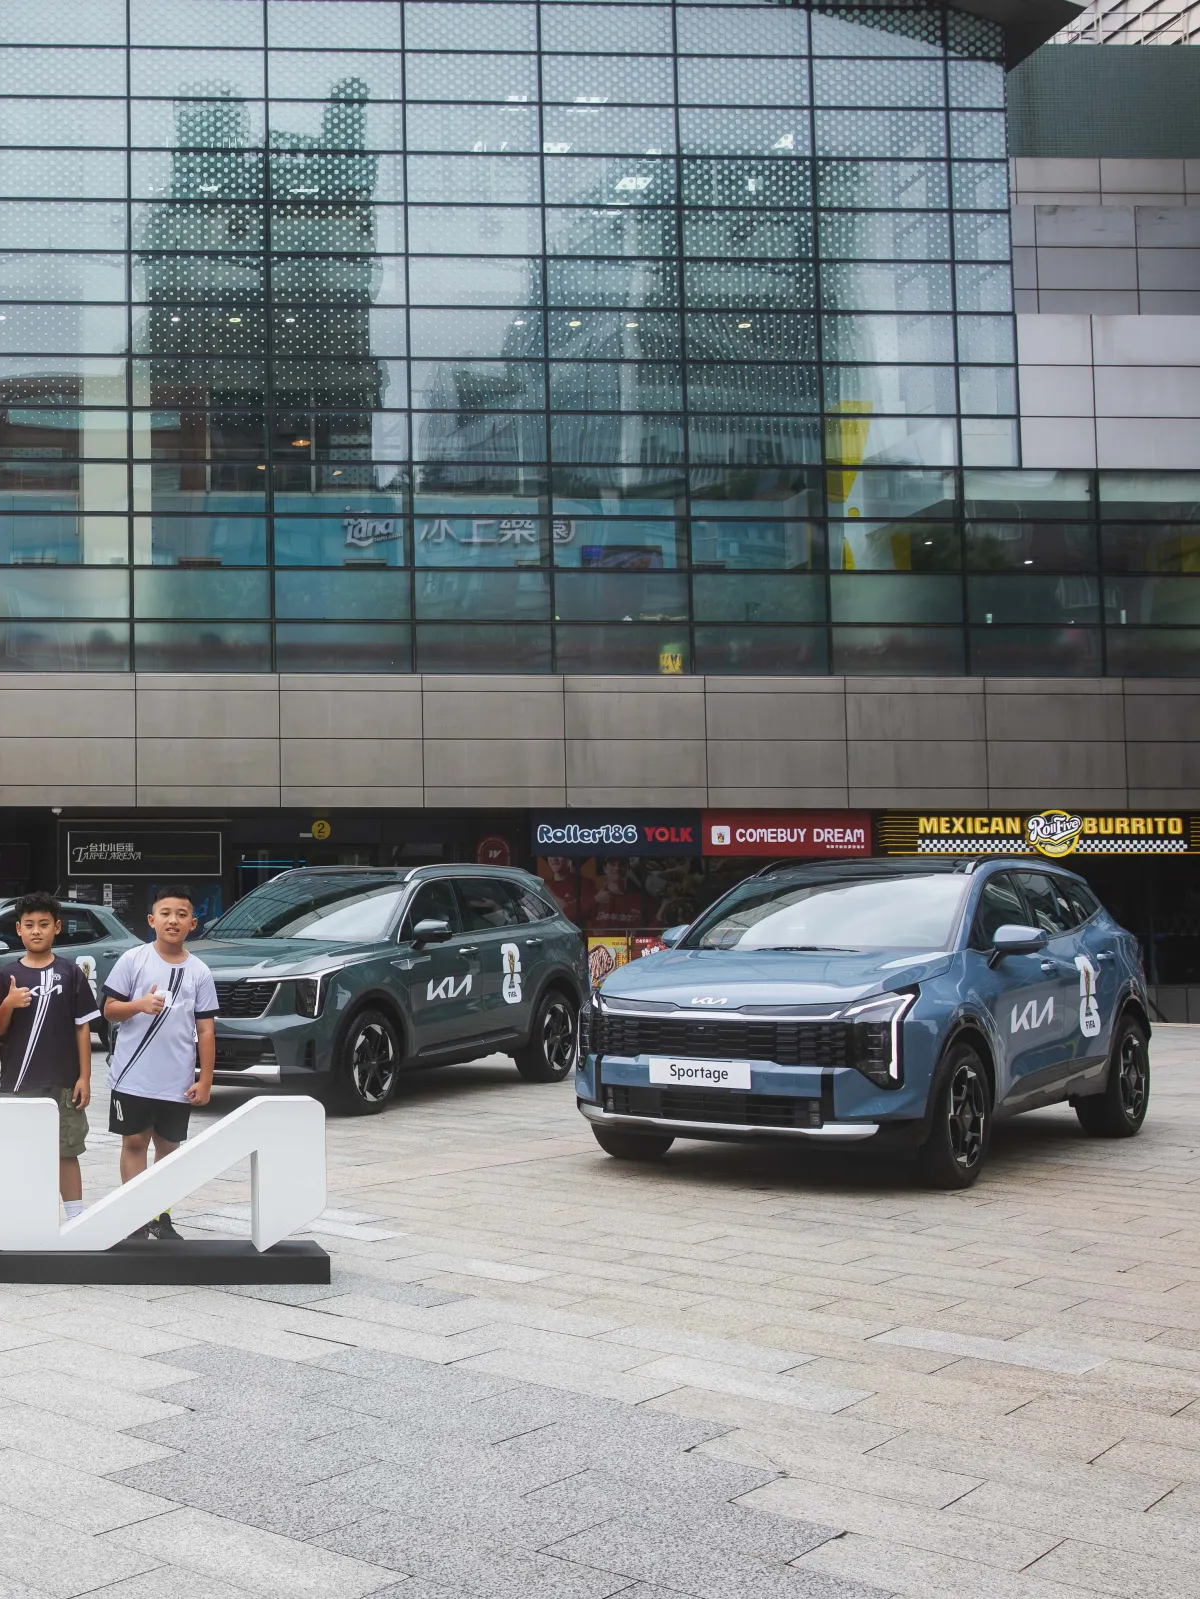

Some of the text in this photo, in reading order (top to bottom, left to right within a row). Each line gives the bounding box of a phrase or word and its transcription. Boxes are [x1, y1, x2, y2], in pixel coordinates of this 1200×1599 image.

[317, 822, 326, 834] 2
[918, 816, 1183, 834] MEXICAN BURRITO
[537, 824, 693, 844] Roller186 YOLK
[735, 828, 864, 843] COMEBUY DREAM
[89, 843, 134, 852] 台北小巨蛋
[109, 851, 142, 861] ARENA
[426, 974, 473, 1001] KIA
[691, 996, 729, 1005] KIA
[1010, 996, 1054, 1034] KIA
[669, 1063, 729, 1083] Sportage
